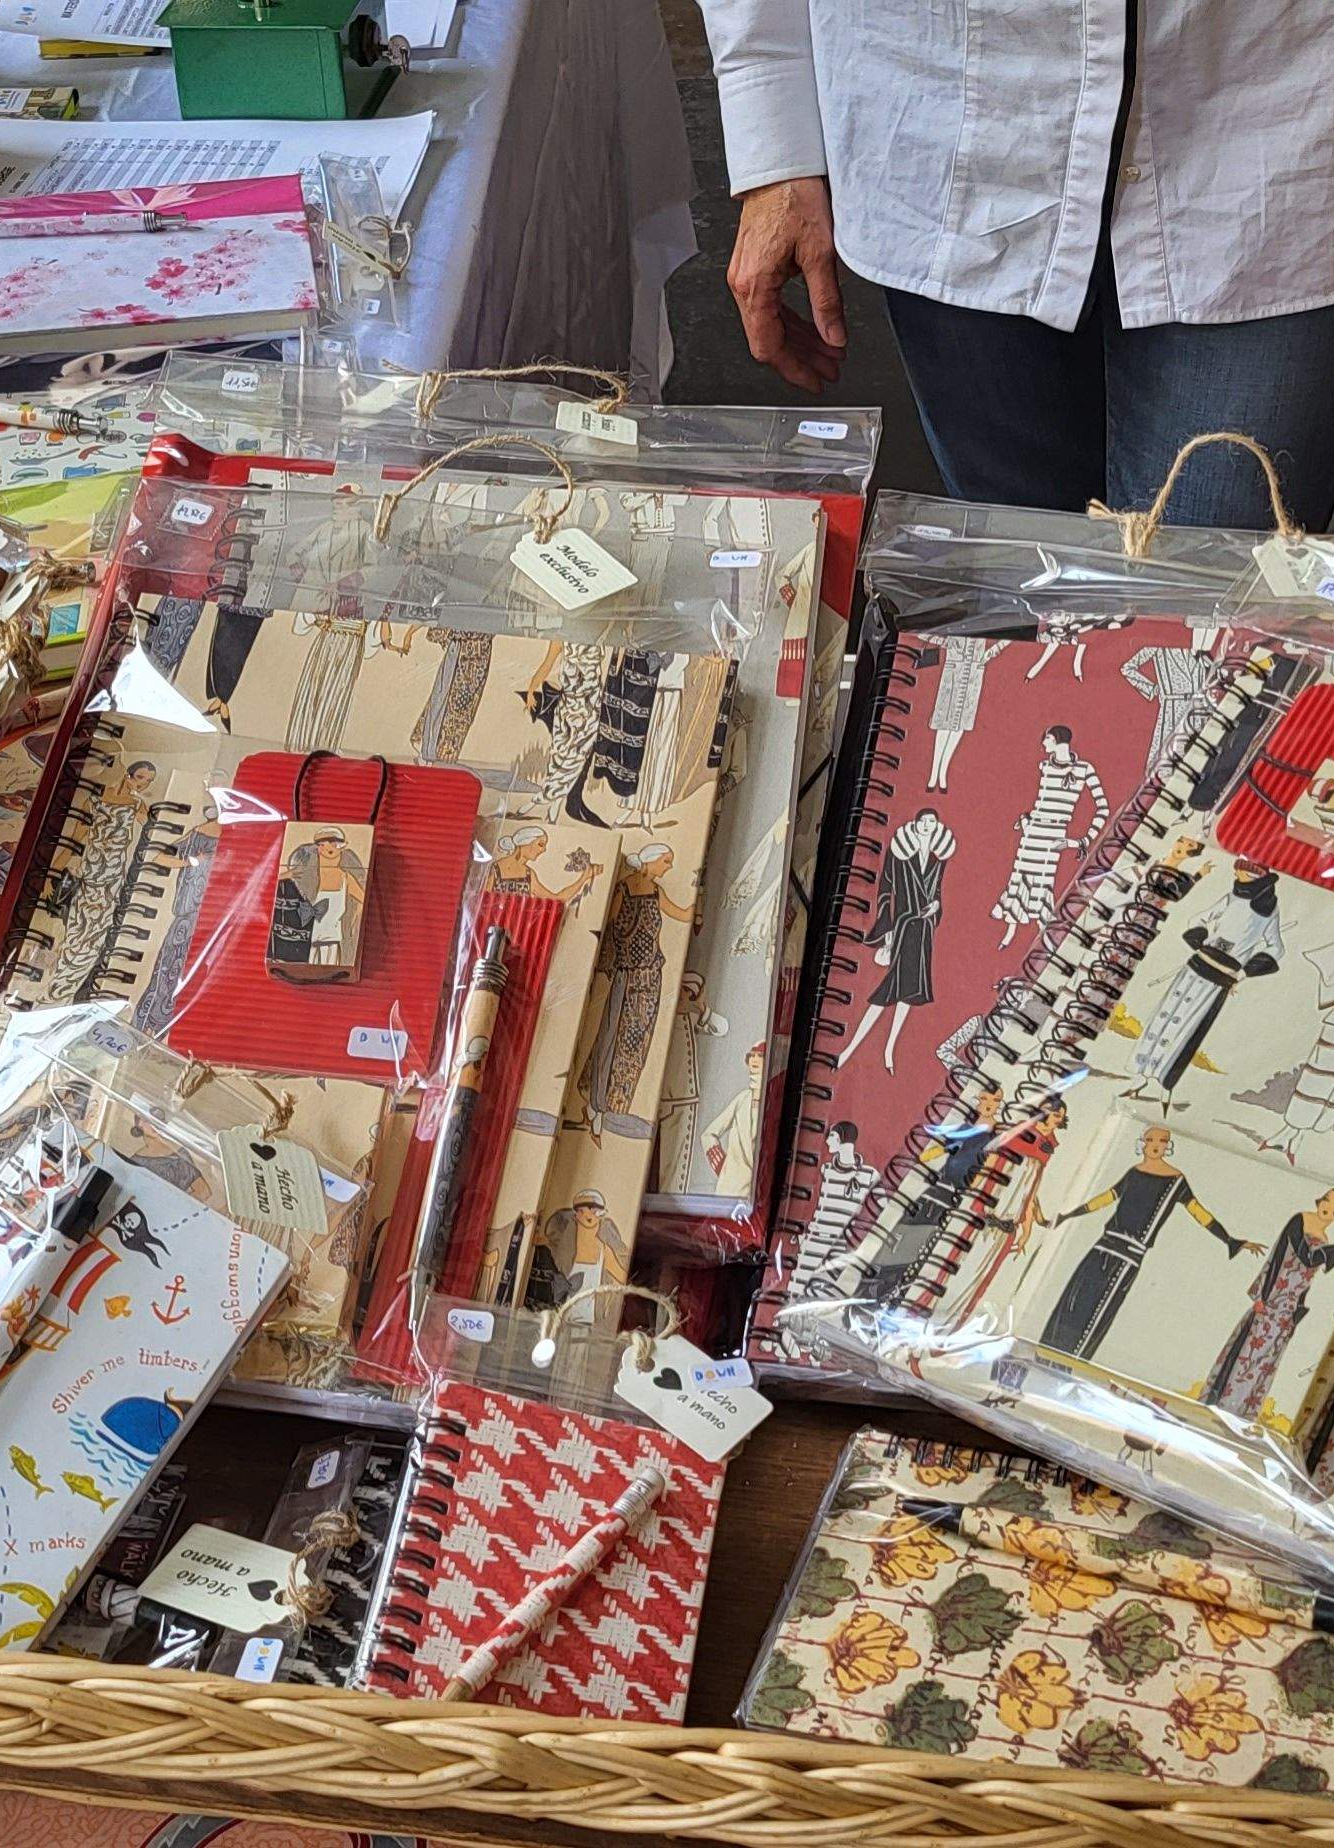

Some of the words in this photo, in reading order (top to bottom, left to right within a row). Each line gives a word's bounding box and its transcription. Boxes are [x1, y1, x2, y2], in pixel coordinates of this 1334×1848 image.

[539, 552, 590, 594] exclusivo
[556, 544, 598, 579] Modelo
[251, 1161, 263, 1171] a
[253, 1173, 271, 1214] mano
[275, 1165, 299, 1211] Hecho
[51, 1368, 95, 1415] Shiver
[100, 1354, 126, 1373] me
[138, 1347, 211, 1376] timbers!
[676, 1392, 688, 1404] a
[689, 1401, 727, 1431] mano
[700, 1387, 739, 1415] echo
[3, 1538, 18, 1556] X
[28, 1532, 87, 1552] marks
[180, 1548, 235, 1573] mano
[236, 1566, 251, 1577] a
[176, 1568, 238, 1598] Hecho
